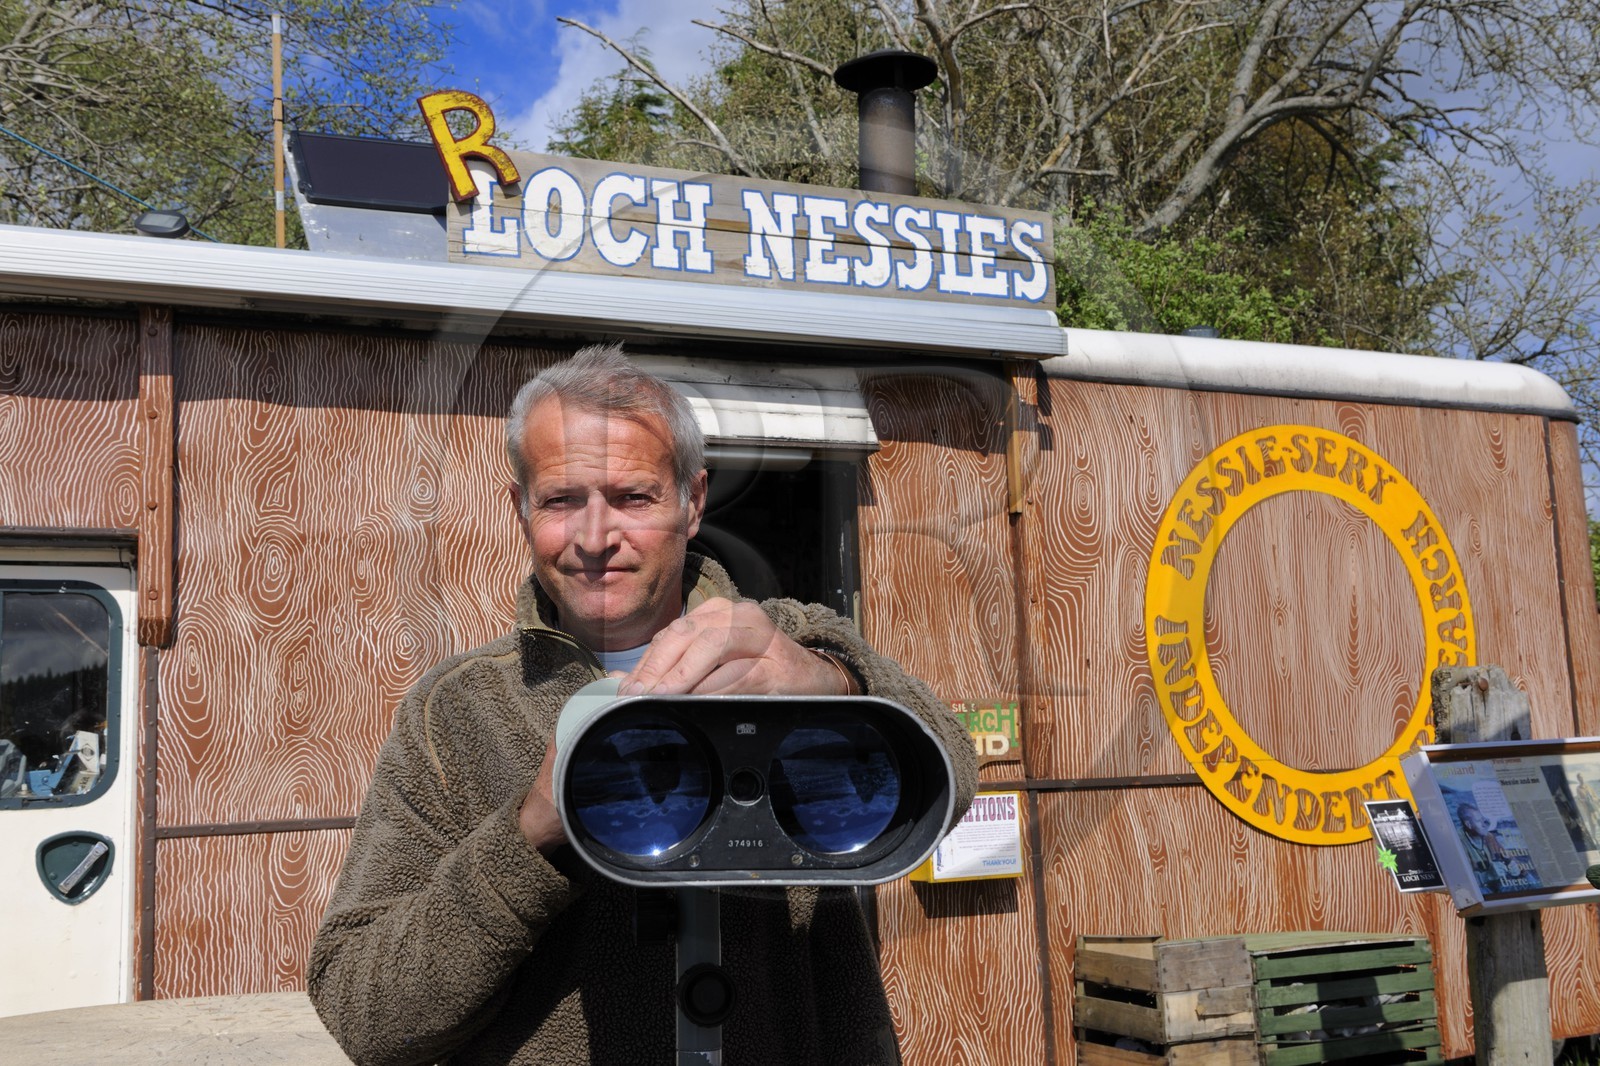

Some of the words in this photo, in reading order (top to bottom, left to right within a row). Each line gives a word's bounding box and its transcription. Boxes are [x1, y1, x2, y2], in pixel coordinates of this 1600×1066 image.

[742, 188, 1048, 303] NESSIES
[1160, 434, 1397, 580] NESSIE-SERY
[1154, 615, 1400, 833] INDEPENDENT
[728, 839, 764, 848] 374916
[961, 796, 1016, 822] ATIONS
